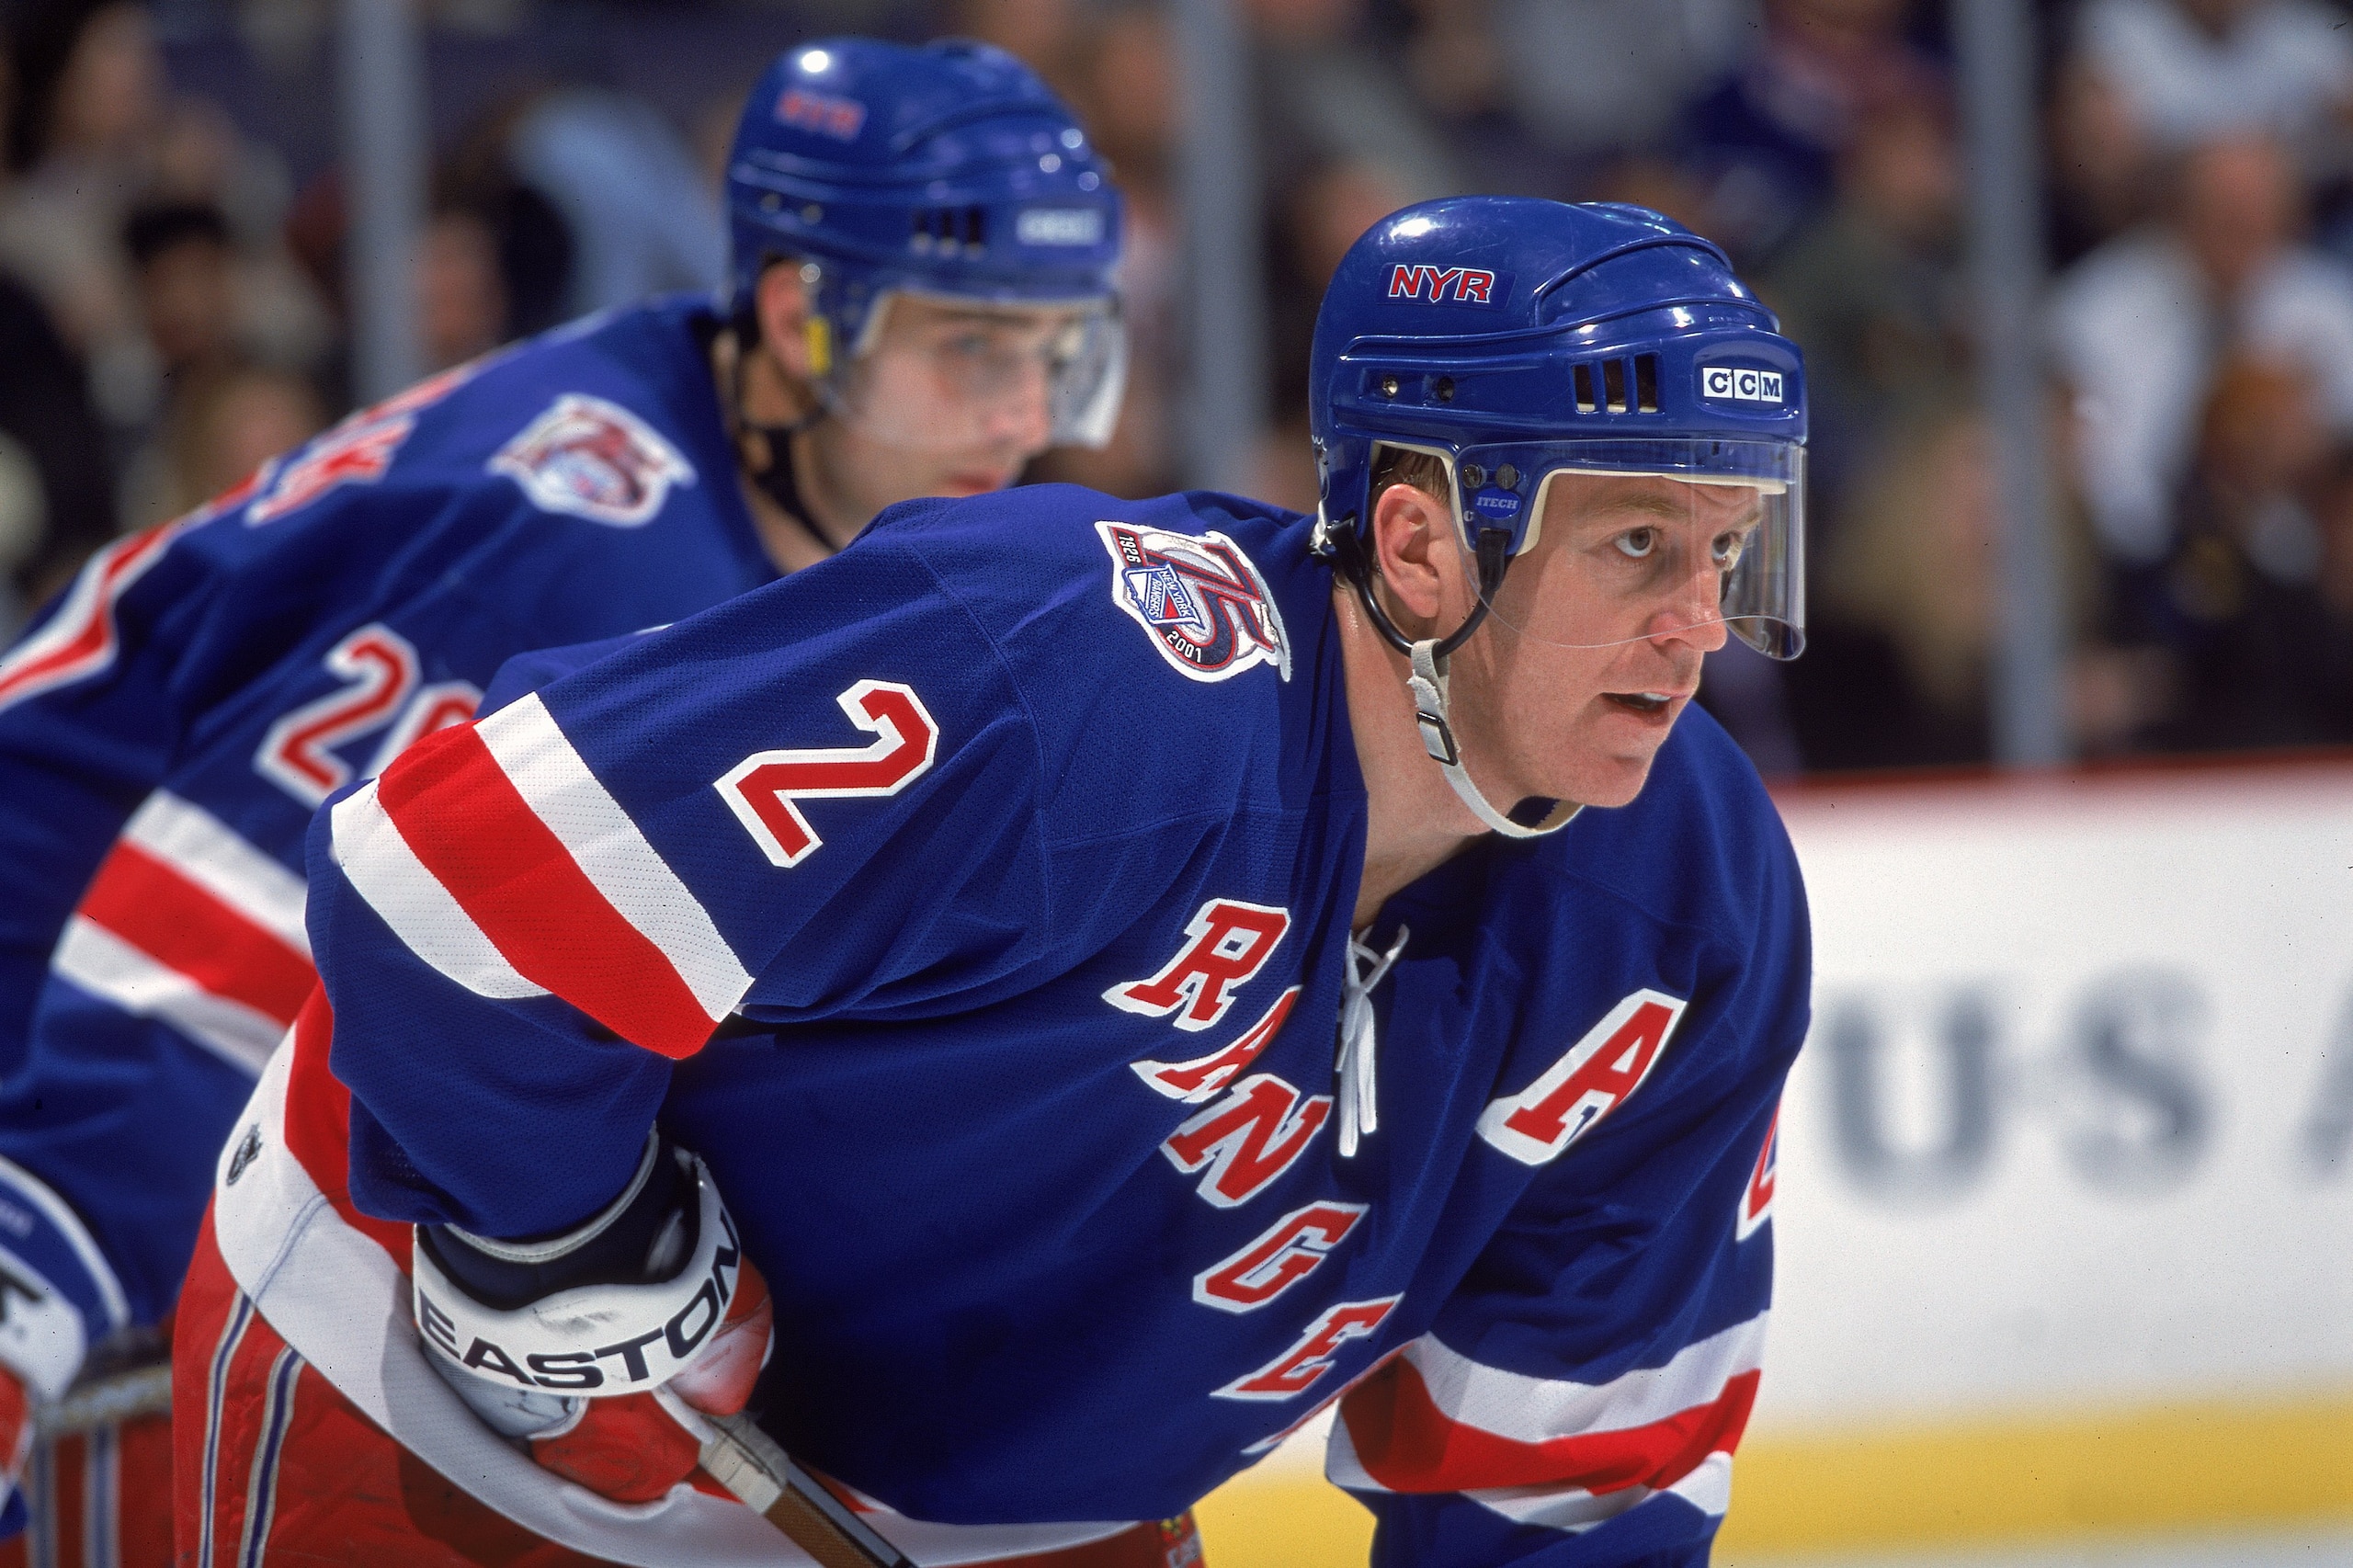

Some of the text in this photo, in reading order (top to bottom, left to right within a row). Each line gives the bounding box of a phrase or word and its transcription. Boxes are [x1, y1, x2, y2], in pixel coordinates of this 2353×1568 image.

[1388, 264, 1495, 303] NYR
[1707, 371, 1780, 398] CCM
[1476, 496, 1518, 510] ITECH
[1119, 535, 1142, 563] 1926
[1160, 570, 1192, 618] NEW YORK
[1165, 631, 1202, 663] 2001
[712, 678, 939, 869] 2
[1474, 987, 1688, 1166] A
[1101, 897, 1415, 1454] RANGE
[420, 1208, 741, 1389] EASTON
